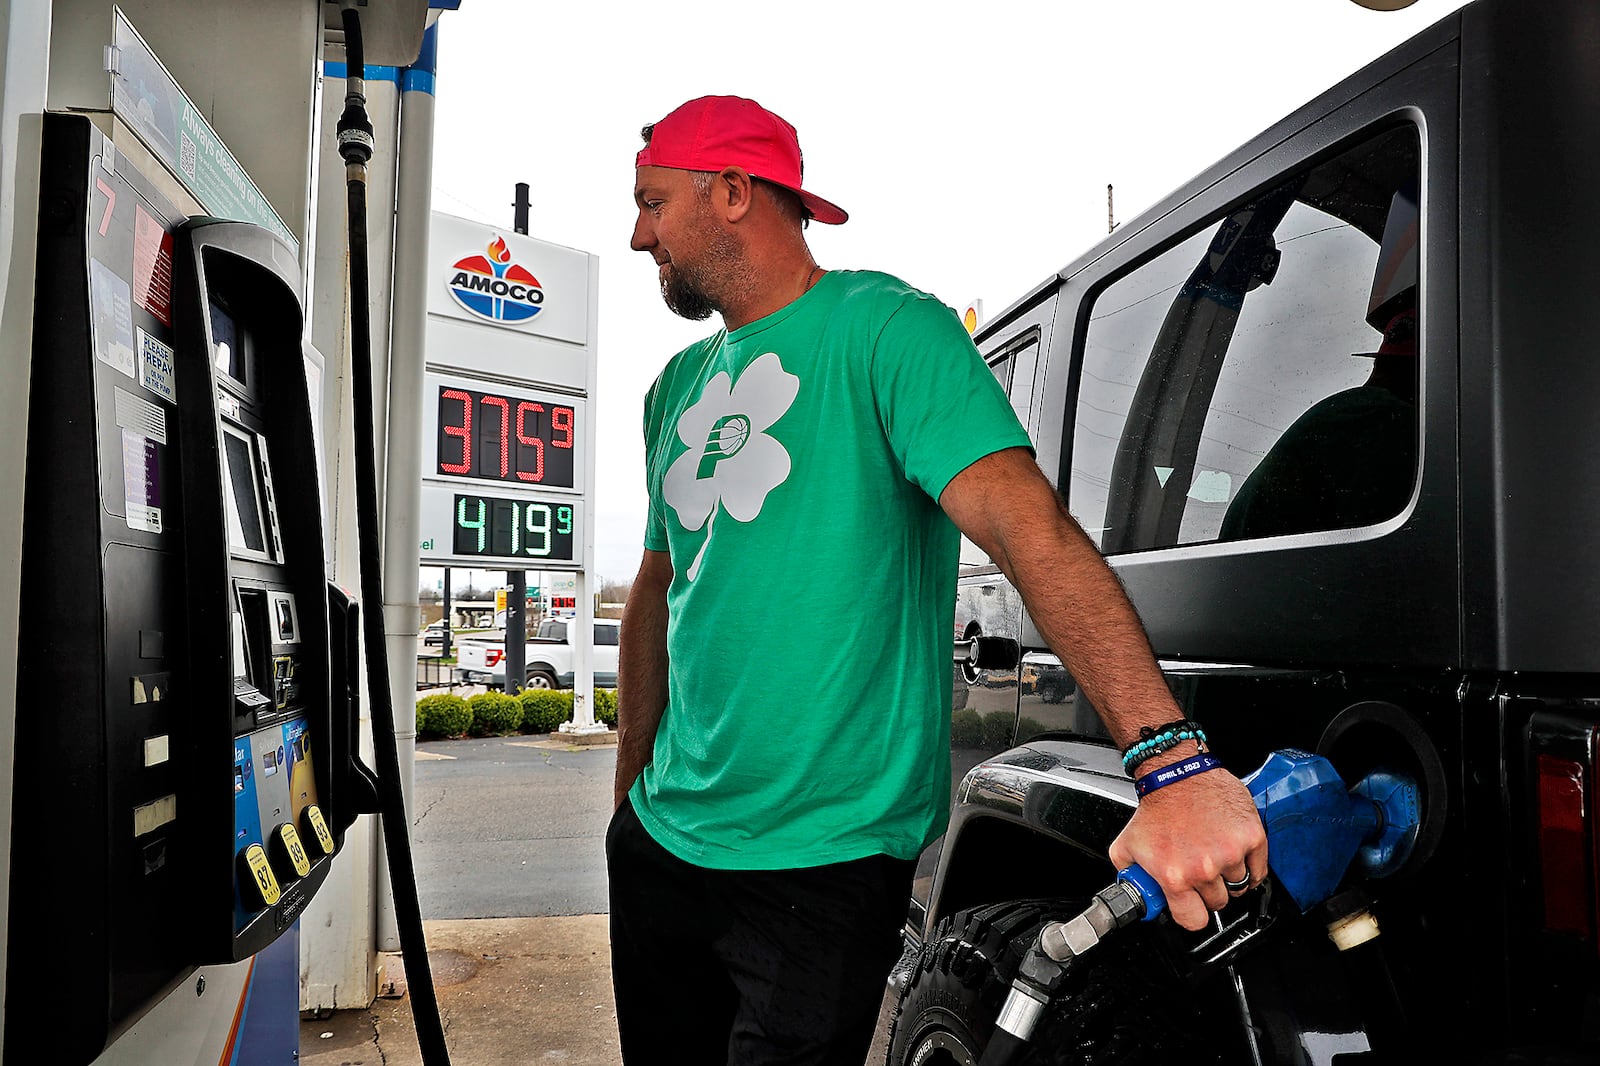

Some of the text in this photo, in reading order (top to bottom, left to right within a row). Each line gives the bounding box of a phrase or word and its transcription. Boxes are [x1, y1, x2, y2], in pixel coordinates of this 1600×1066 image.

[182, 103, 215, 157] Always
[215, 148, 246, 200] cleaning
[246, 189, 257, 209] on
[96, 177, 116, 237] 7
[449, 272, 545, 304] AMOCO
[144, 336, 169, 362] PLEASE
[1157, 770, 1177, 783] APRIL
[1184, 761, 1201, 773] 2023
[316, 822, 328, 842] 93
[290, 841, 304, 864] 89
[257, 865, 272, 890] 87
